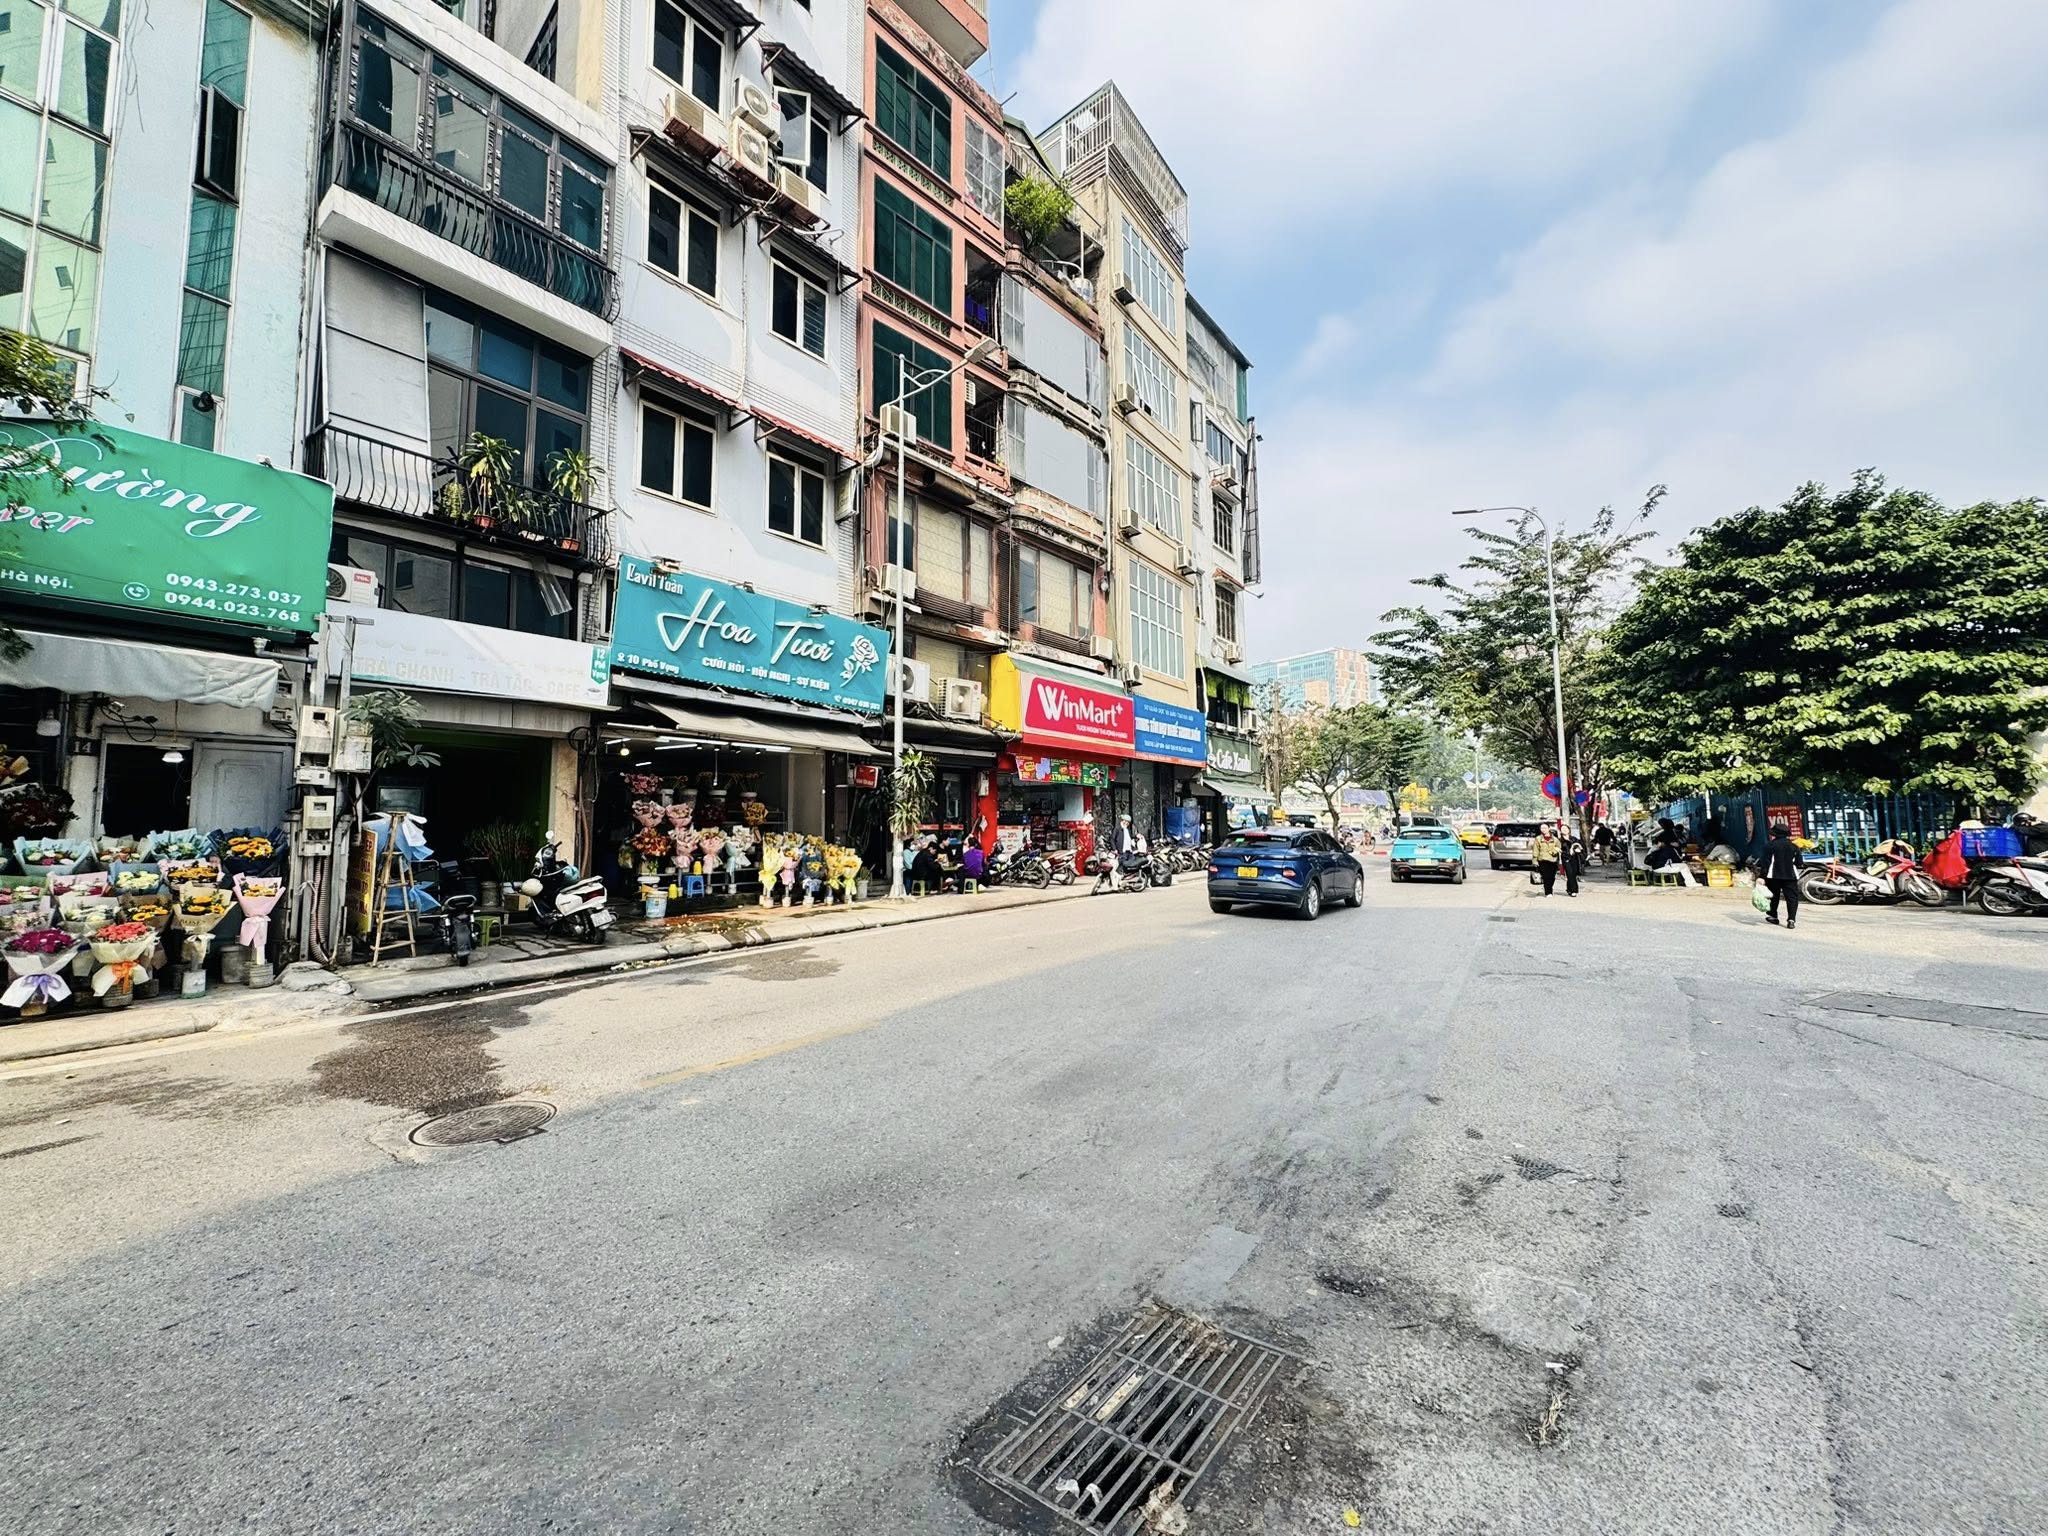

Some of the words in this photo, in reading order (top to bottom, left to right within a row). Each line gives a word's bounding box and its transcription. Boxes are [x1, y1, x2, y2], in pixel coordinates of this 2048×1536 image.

[0, 568, 29, 583] Hà
[35, 573, 73, 589] Nội.
[166, 573, 301, 605] 0943.273.037
[164, 592, 300, 622] 0944.023.768
[657, 588, 757, 652] Hoa
[770, 620, 836, 665] Tươi
[596, 649, 606, 659] 12
[627, 654, 639, 665] 10
[642, 657, 659, 669] Phố
[660, 661, 679, 675] Vọng
[702, 656, 726, 670] CƯỚI
[396, 660, 454, 682] CHANH
[796, 676, 809, 688] SỰ
[73, 741, 92, 754] 14
[1216, 748, 1233, 770] Cafe
